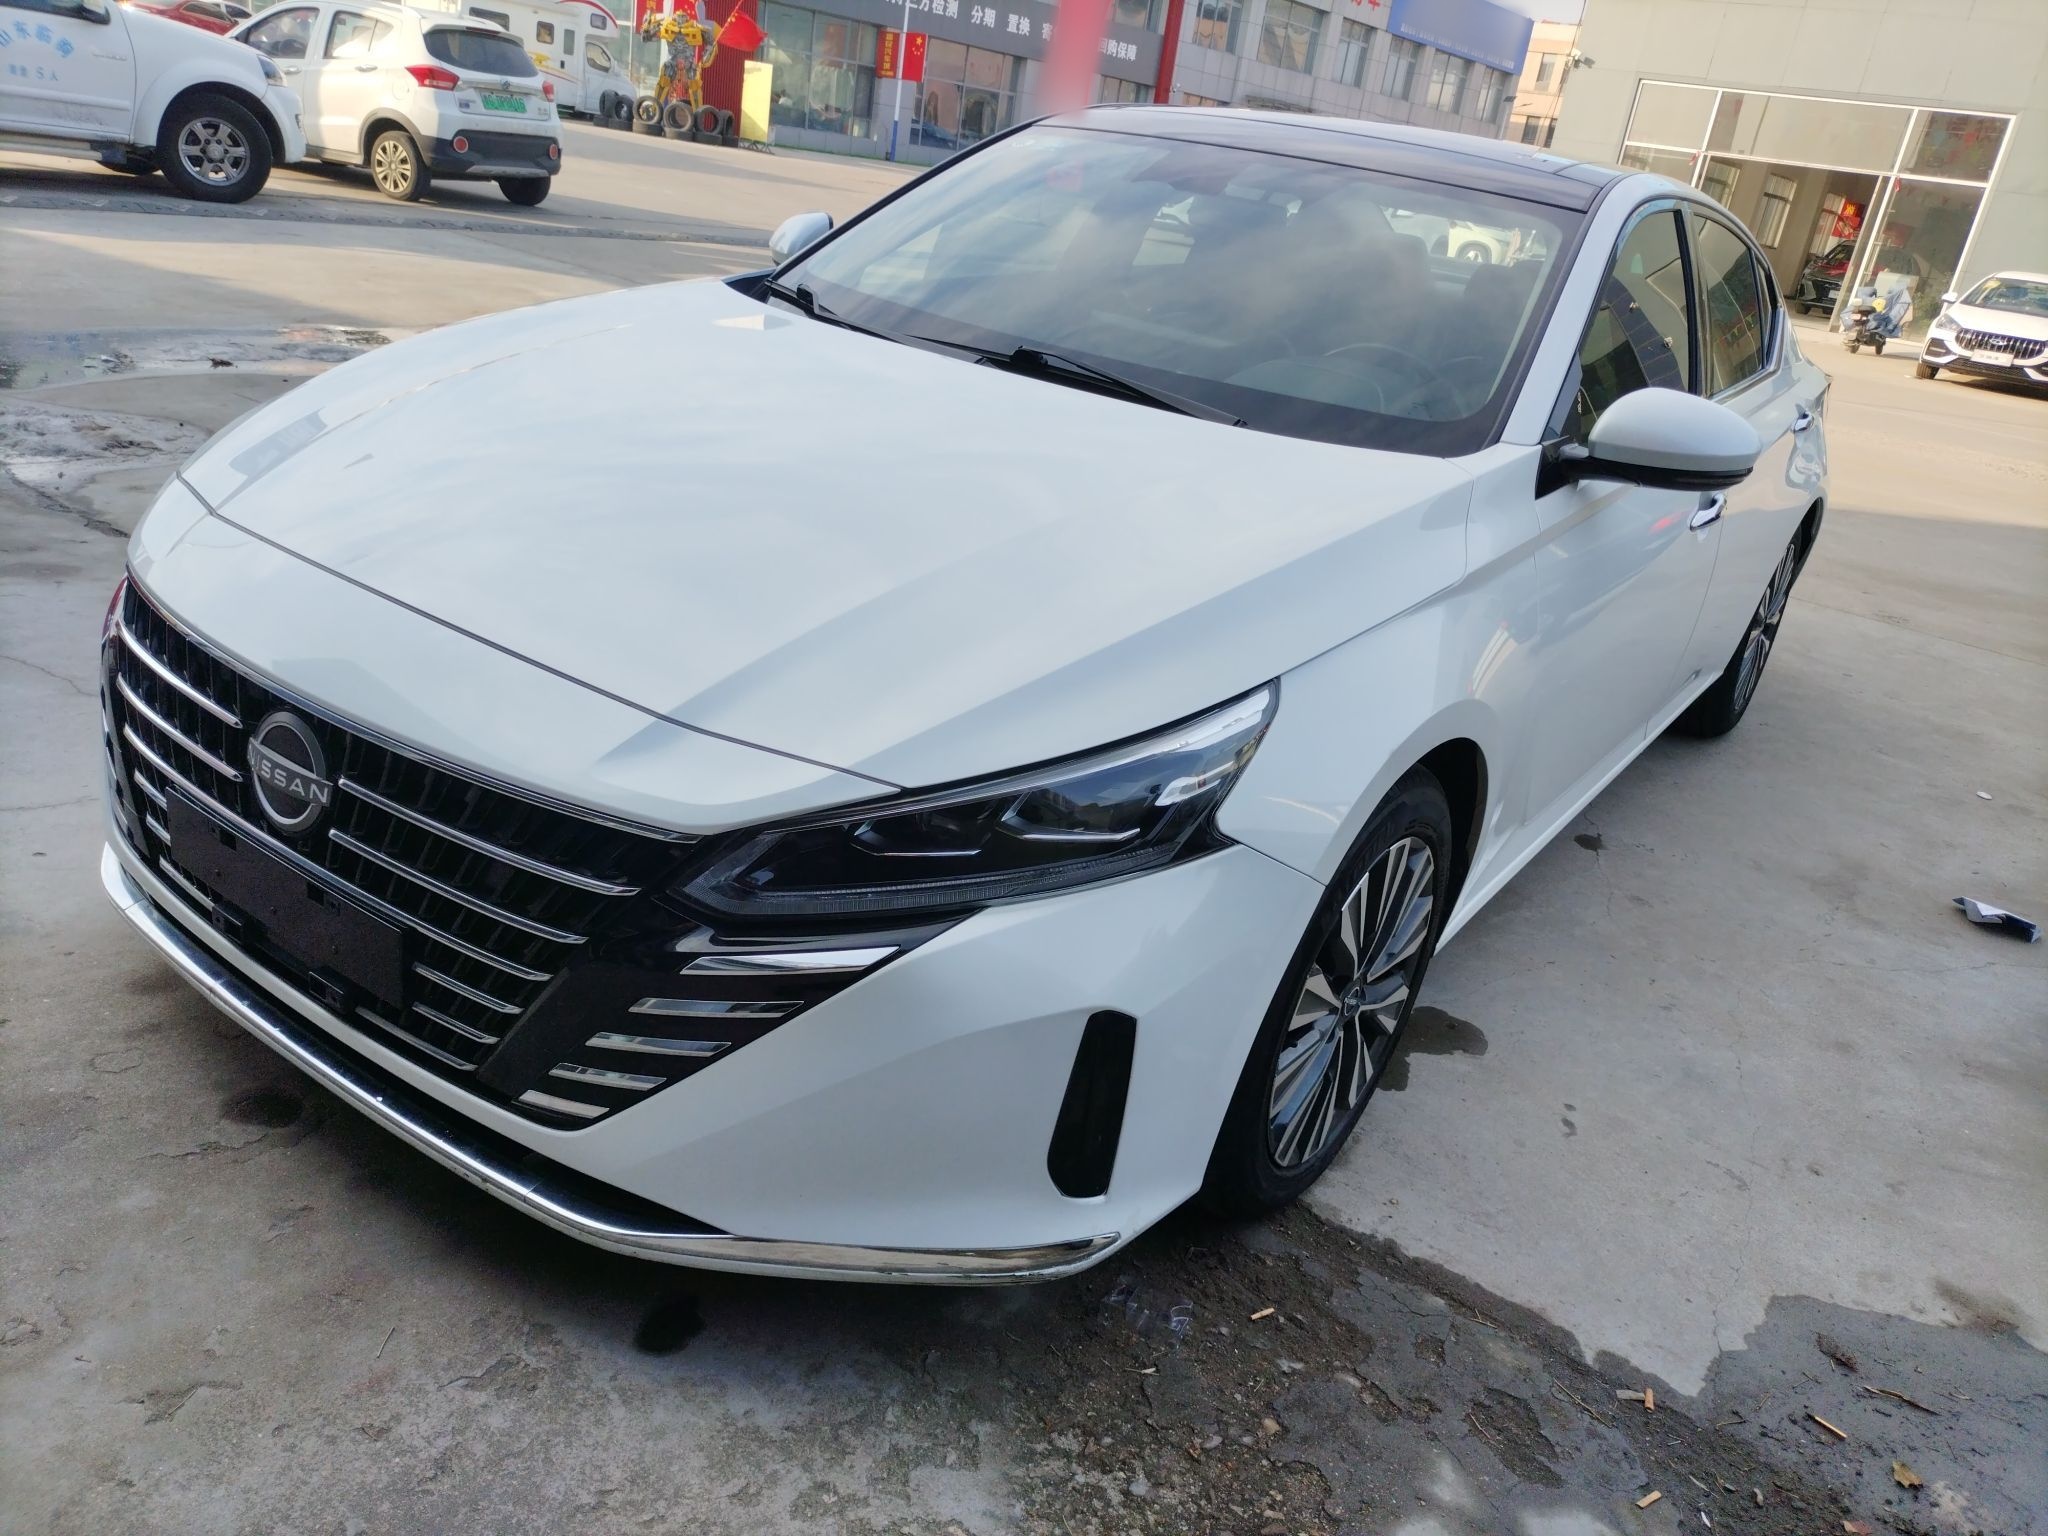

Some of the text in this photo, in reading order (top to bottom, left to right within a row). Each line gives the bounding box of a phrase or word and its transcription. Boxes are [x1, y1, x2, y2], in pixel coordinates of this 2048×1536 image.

[971, 5, 996, 28] 分期
[1006, 14, 1031, 36] 置换
[248, 742, 329, 804] NISSAN
